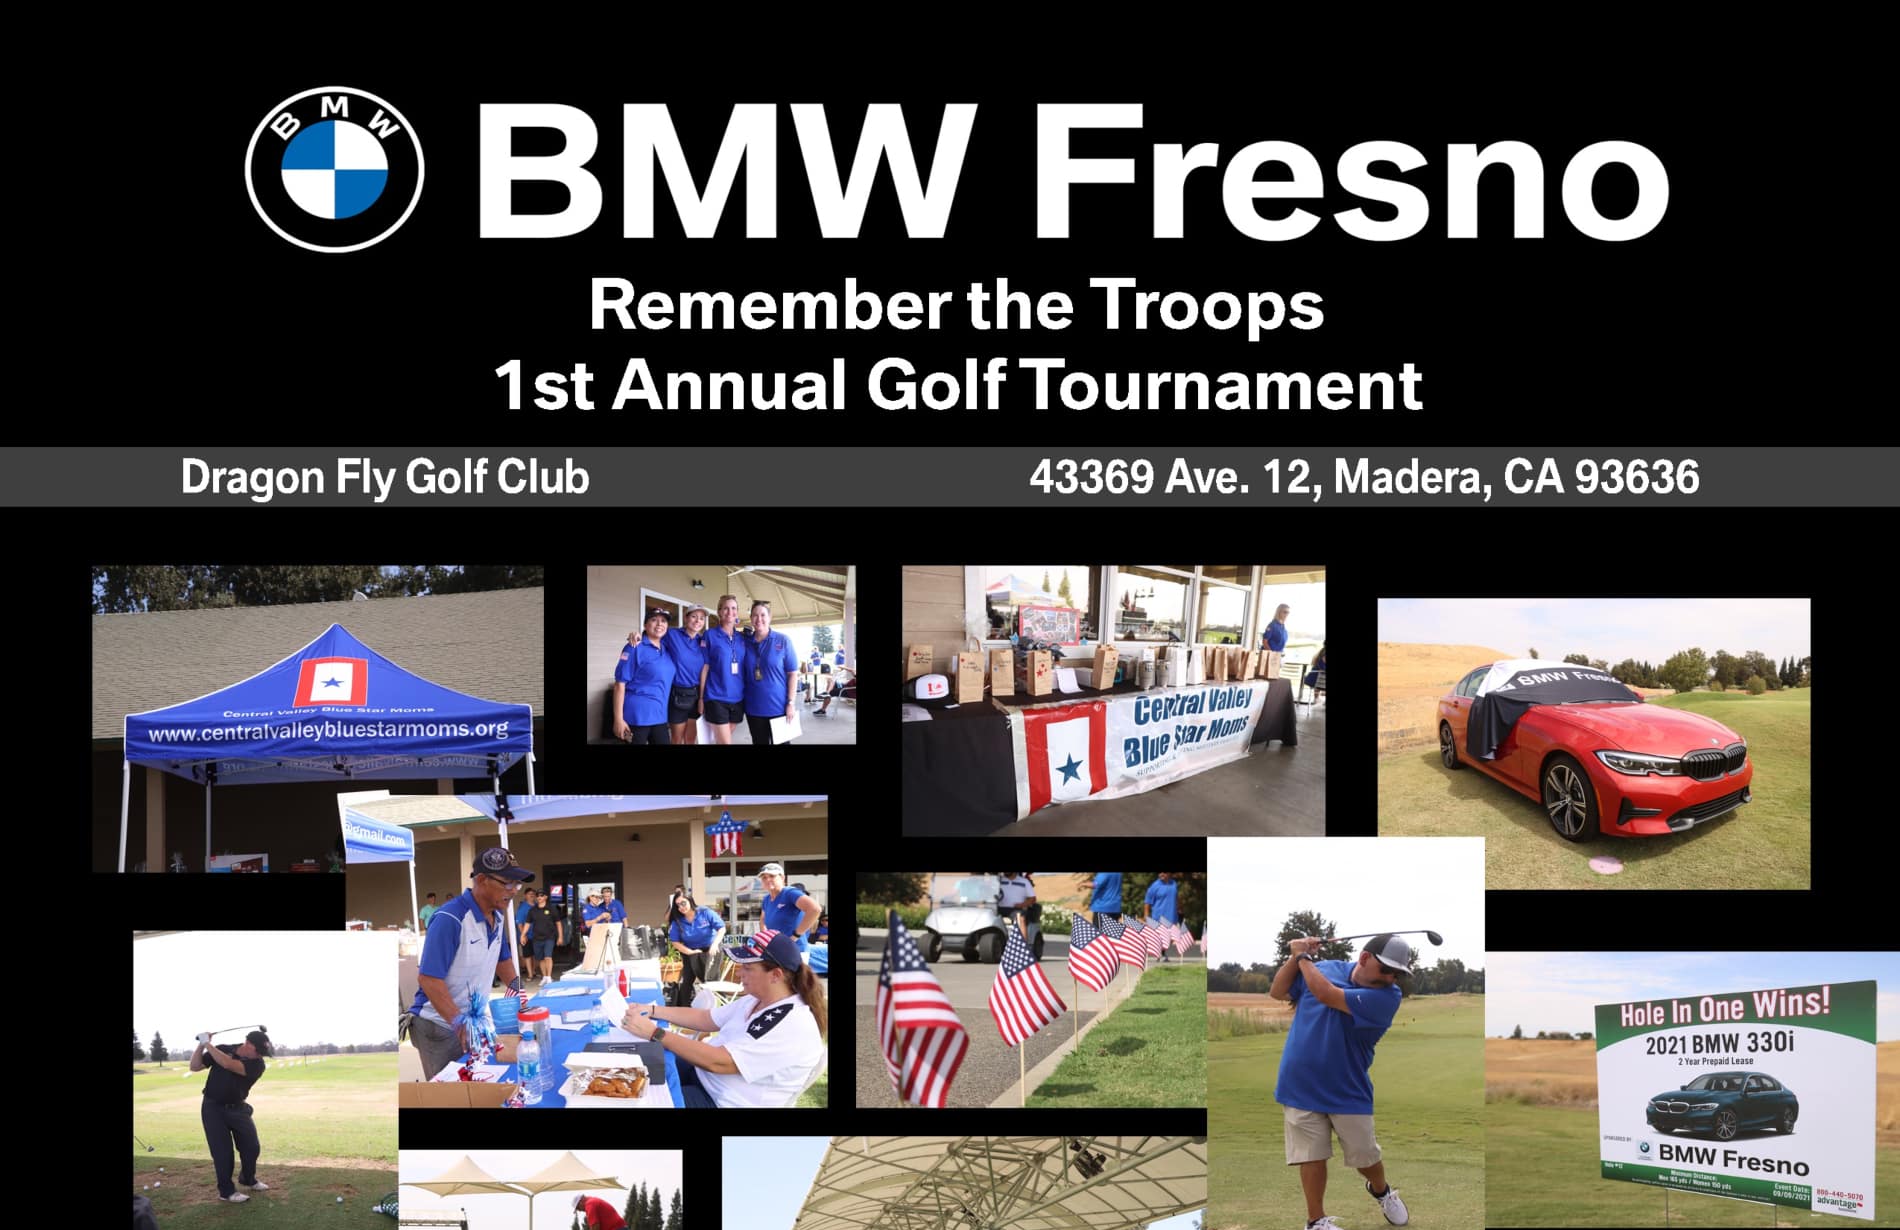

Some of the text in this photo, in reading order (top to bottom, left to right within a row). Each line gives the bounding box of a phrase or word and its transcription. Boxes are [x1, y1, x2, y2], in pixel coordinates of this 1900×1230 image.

[1518, 671, 1568, 686] BMW
[223, 710, 273, 718] Central
[278, 707, 318, 716] Valley
[1134, 686, 1253, 726] Central Valley
[148, 719, 509, 744] www.centralvalleybluestarmoms.org
[1124, 733, 1171, 768] Blue
[1174, 724, 1207, 750] Star
[1207, 715, 1249, 741] Moms
[1620, 984, 1831, 1028] Hole In One Wins!
[1646, 1030, 1794, 1056] 2021 BMW 330i
[1678, 1057, 1754, 1067] 2 Year Prepaid Lease
[1659, 1143, 1810, 1177] BMW Fresno
[1773, 1190, 1810, 1201] 09/09/2021
[1774, 1182, 1792, 1191] Event
[1817, 1196, 1857, 1209] advantage
